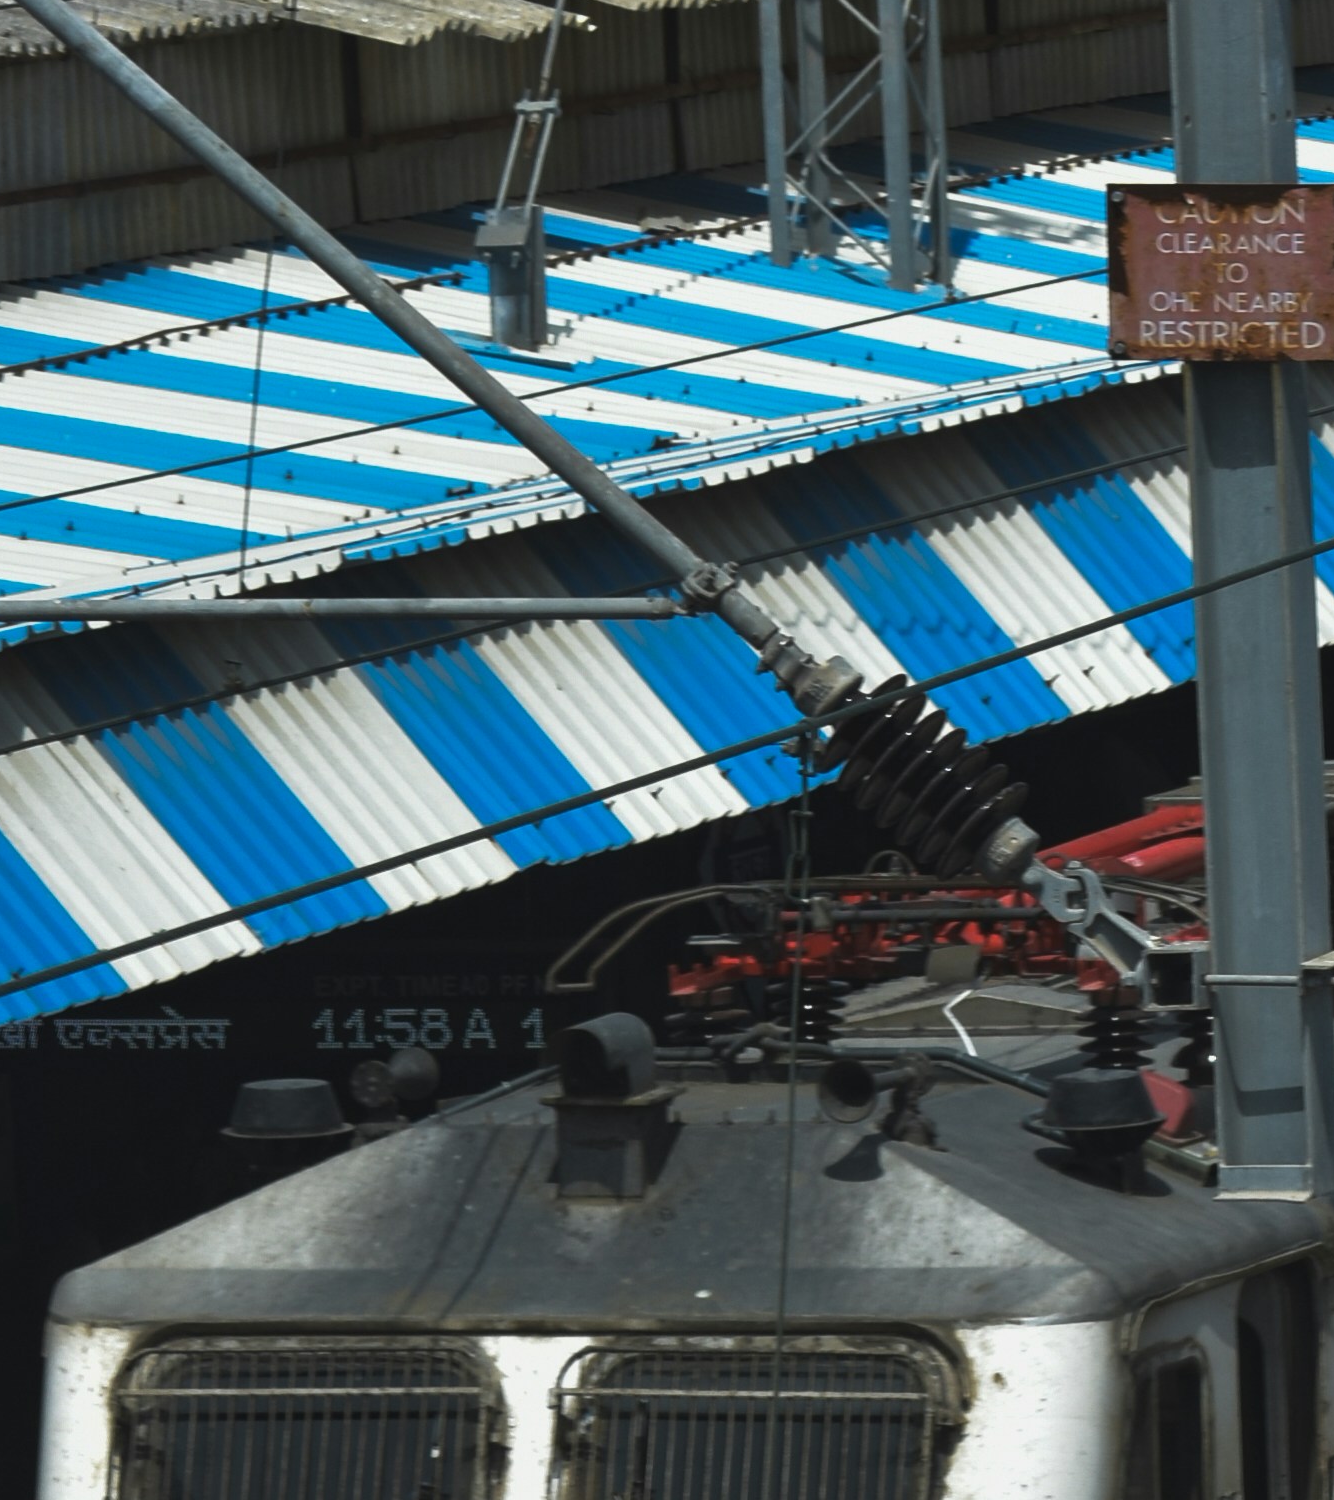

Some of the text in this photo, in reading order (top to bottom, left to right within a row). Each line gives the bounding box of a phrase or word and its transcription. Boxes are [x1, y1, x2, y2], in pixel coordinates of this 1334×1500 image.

[1155, 232, 1306, 254] CLEARANCE
[1216, 262, 1249, 284] TO
[1149, 291, 1313, 314] OHE NEARBY
[1139, 320, 1326, 349] RESTRICTED
[312, 1008, 454, 1049] 11:58
[462, 1008, 497, 1049] A
